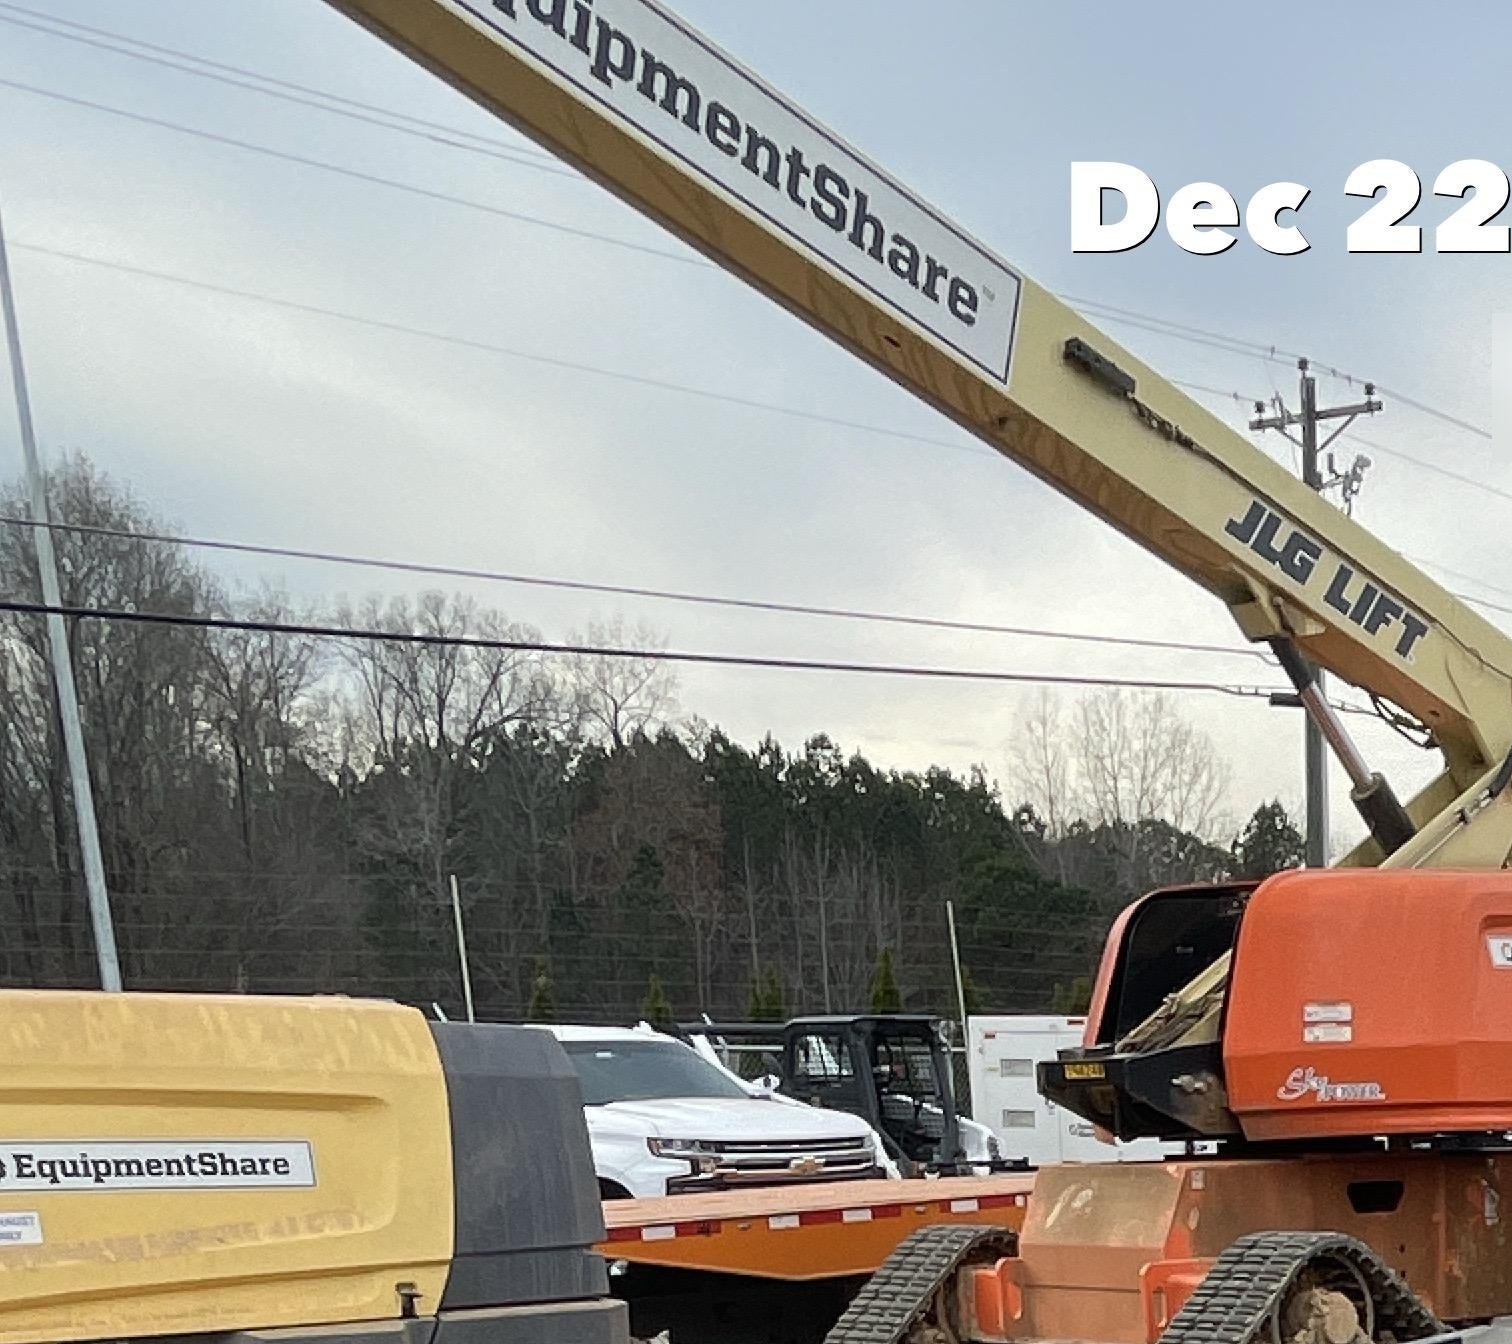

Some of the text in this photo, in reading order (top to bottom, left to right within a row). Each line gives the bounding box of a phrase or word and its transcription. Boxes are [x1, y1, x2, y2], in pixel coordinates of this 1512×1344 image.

[492, 0, 978, 327] uipmentShare
[1225, 500, 1429, 658] JLG LIFT
[12, 1151, 290, 1185] EquipmentShare
